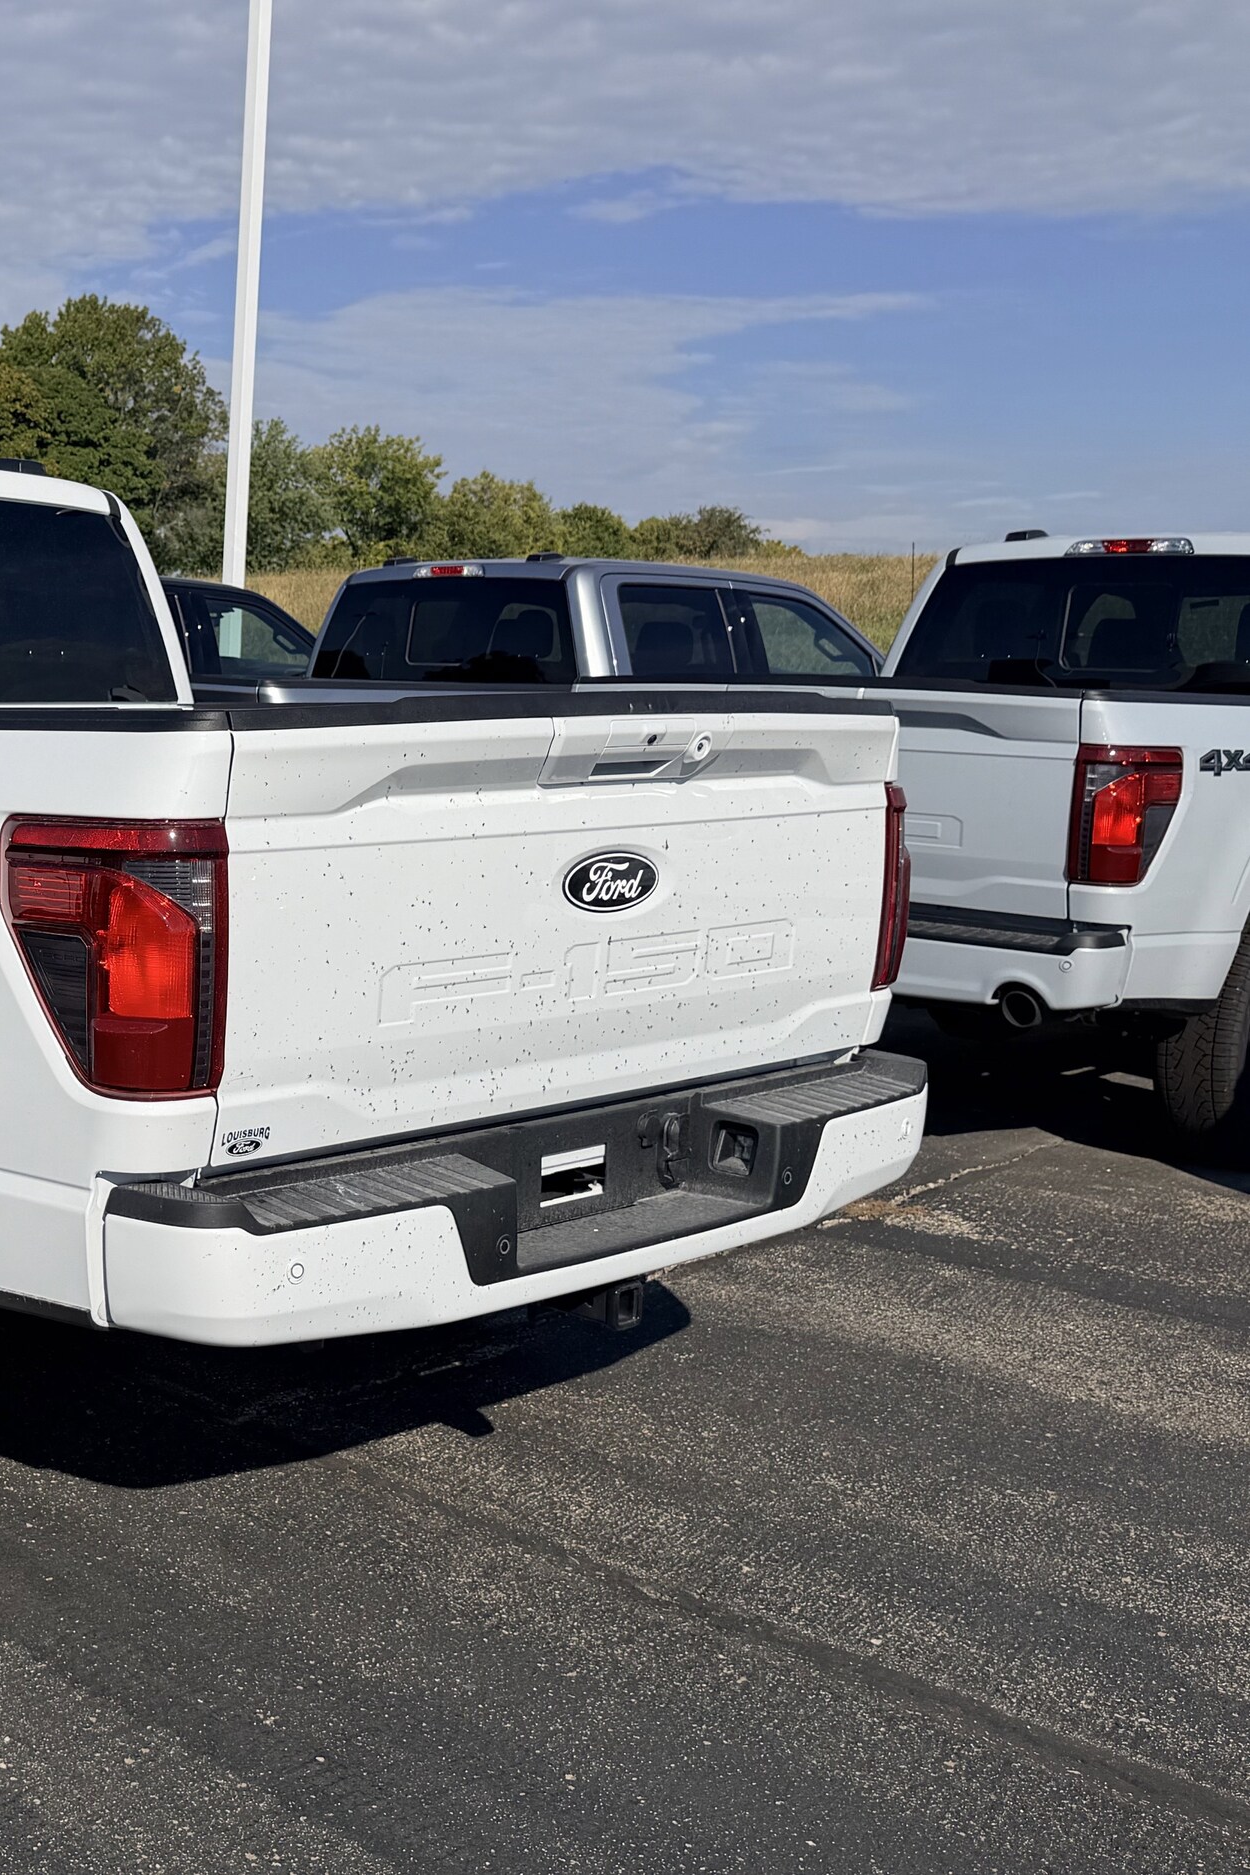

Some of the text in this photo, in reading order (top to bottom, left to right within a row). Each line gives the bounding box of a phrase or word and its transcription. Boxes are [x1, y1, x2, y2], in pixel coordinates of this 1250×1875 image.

[582, 862, 644, 902] Ford
[378, 918, 794, 1026] F-150
[221, 1126, 270, 1147] LOUISBURG
[232, 1141, 256, 1154] Ford
